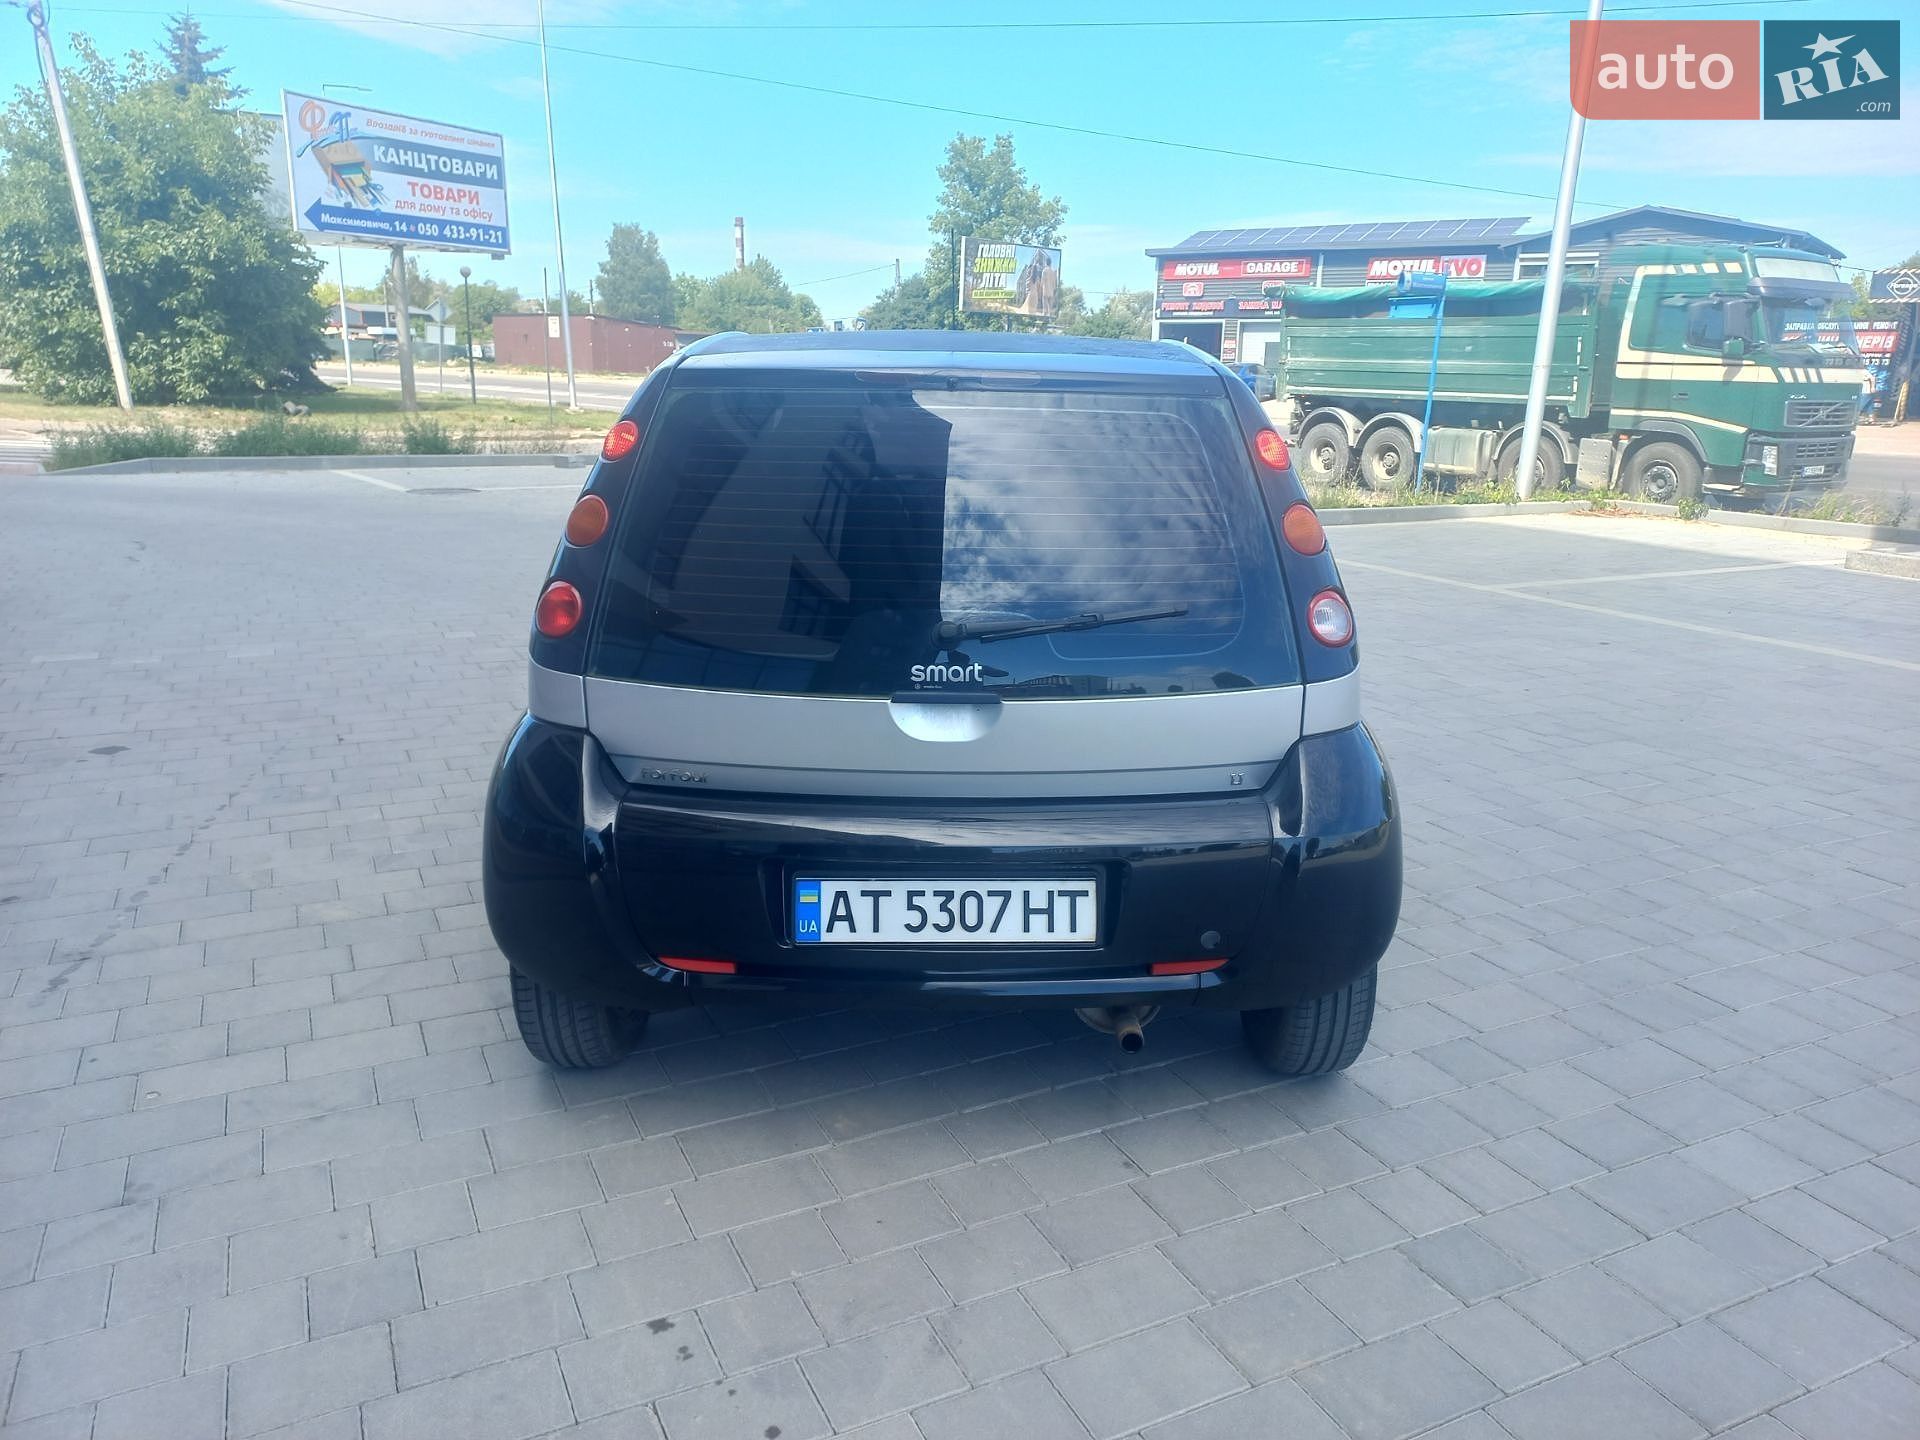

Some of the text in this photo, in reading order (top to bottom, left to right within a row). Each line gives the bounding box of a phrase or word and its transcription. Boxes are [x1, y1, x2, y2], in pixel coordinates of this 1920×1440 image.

[373, 145, 499, 181] КАНЦТОВАРИ
[407, 181, 480, 206] ТОВАРИ
[394, 199, 493, 222] для дому та офісу
[394, 221, 408, 233] 14
[417, 223, 439, 237] 050
[443, 226, 503, 244] 433-91-21
[1174, 261, 1299, 276] MOTUL GARAGE
[1369, 259, 1437, 277] MOTUL
[911, 662, 983, 682] smart
[825, 889, 1090, 934] AT 5307 HT
[799, 919, 818, 933] UA
